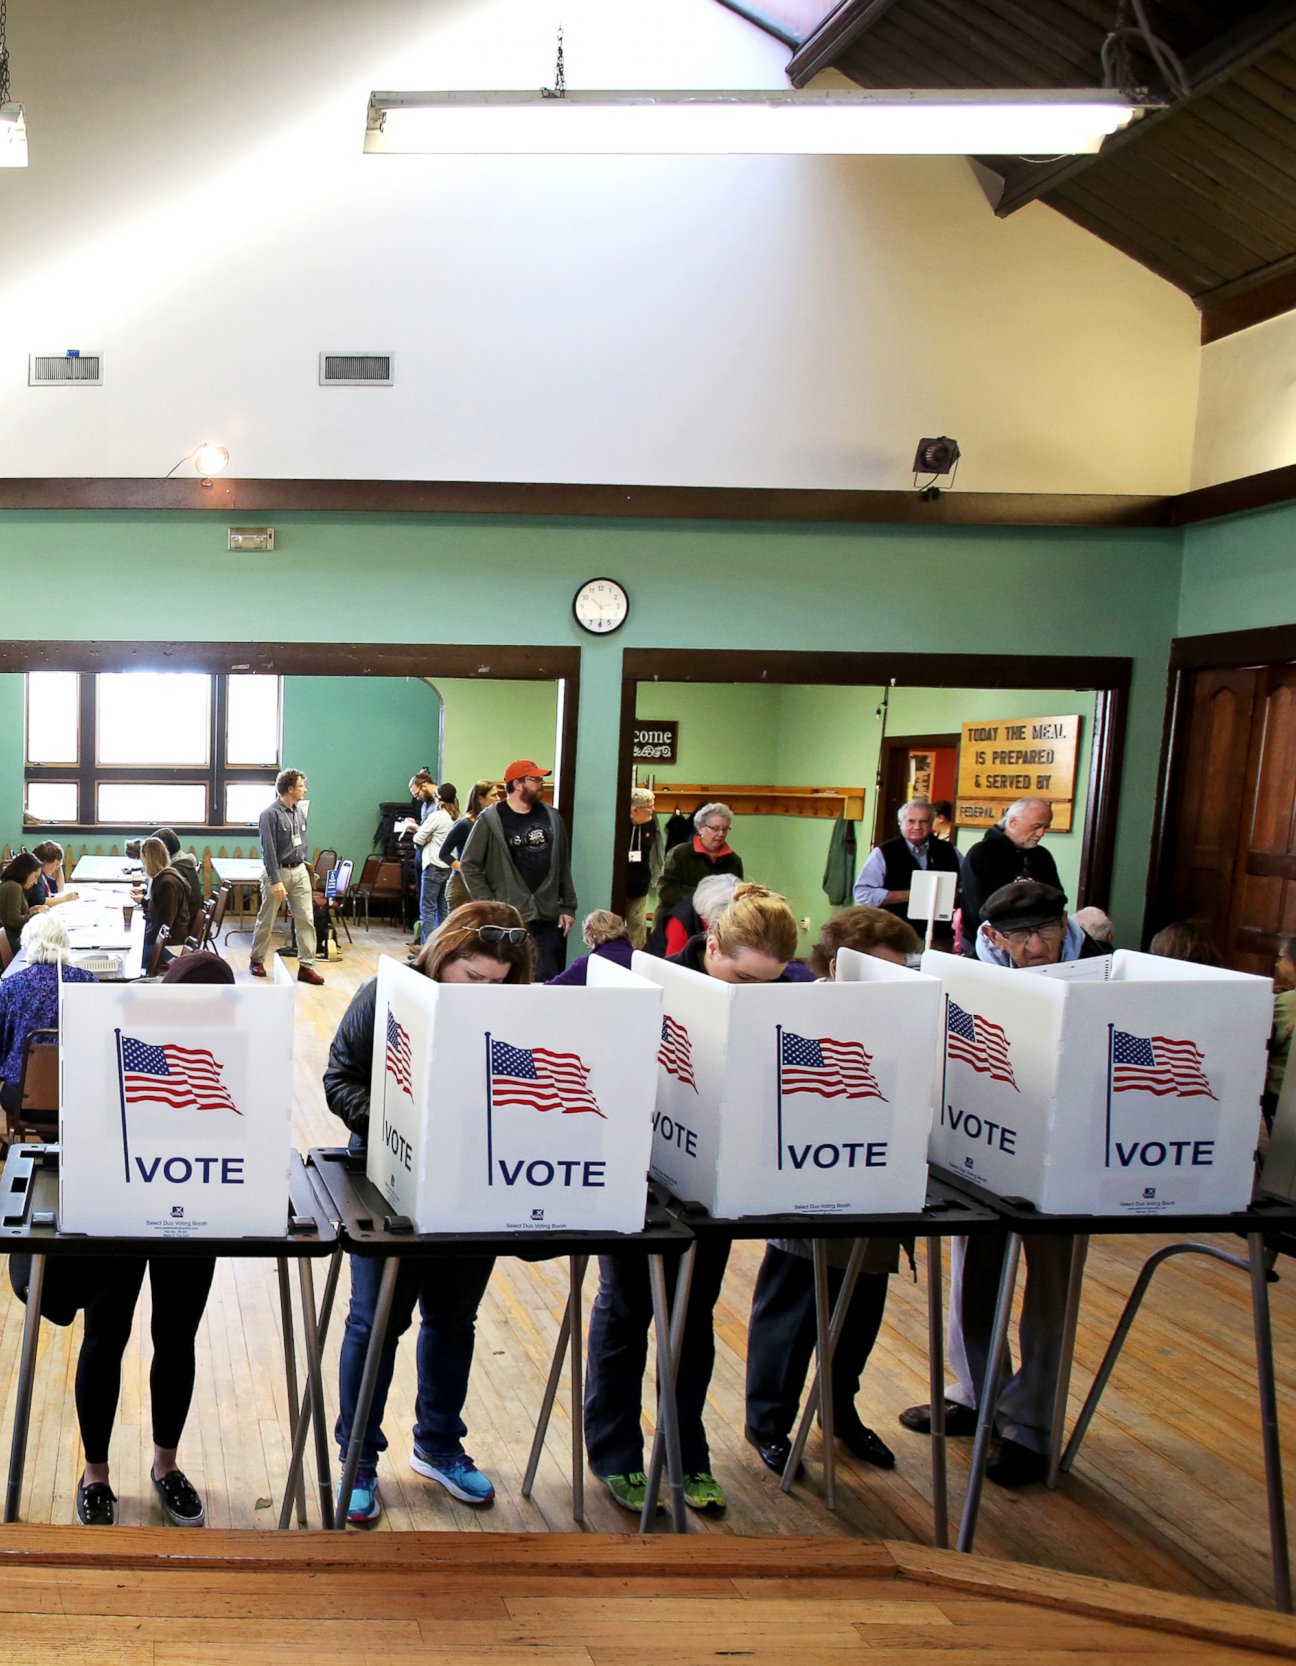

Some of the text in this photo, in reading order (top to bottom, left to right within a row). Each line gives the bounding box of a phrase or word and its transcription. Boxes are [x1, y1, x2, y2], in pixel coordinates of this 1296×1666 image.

[968, 724, 1066, 742] TODAY THE MEAL
[975, 750, 1055, 765] IS PREPARED
[975, 774, 1052, 790] & SERVED BY
[651, 1111, 698, 1159] VOTE
[947, 1105, 1017, 1156] VOTE
[385, 1119, 413, 1172] VOTE
[787, 1142, 888, 1170] VOTE
[1115, 1140, 1216, 1168] VOTE
[134, 1156, 245, 1184] VOTE
[498, 1159, 606, 1188] VOTE
